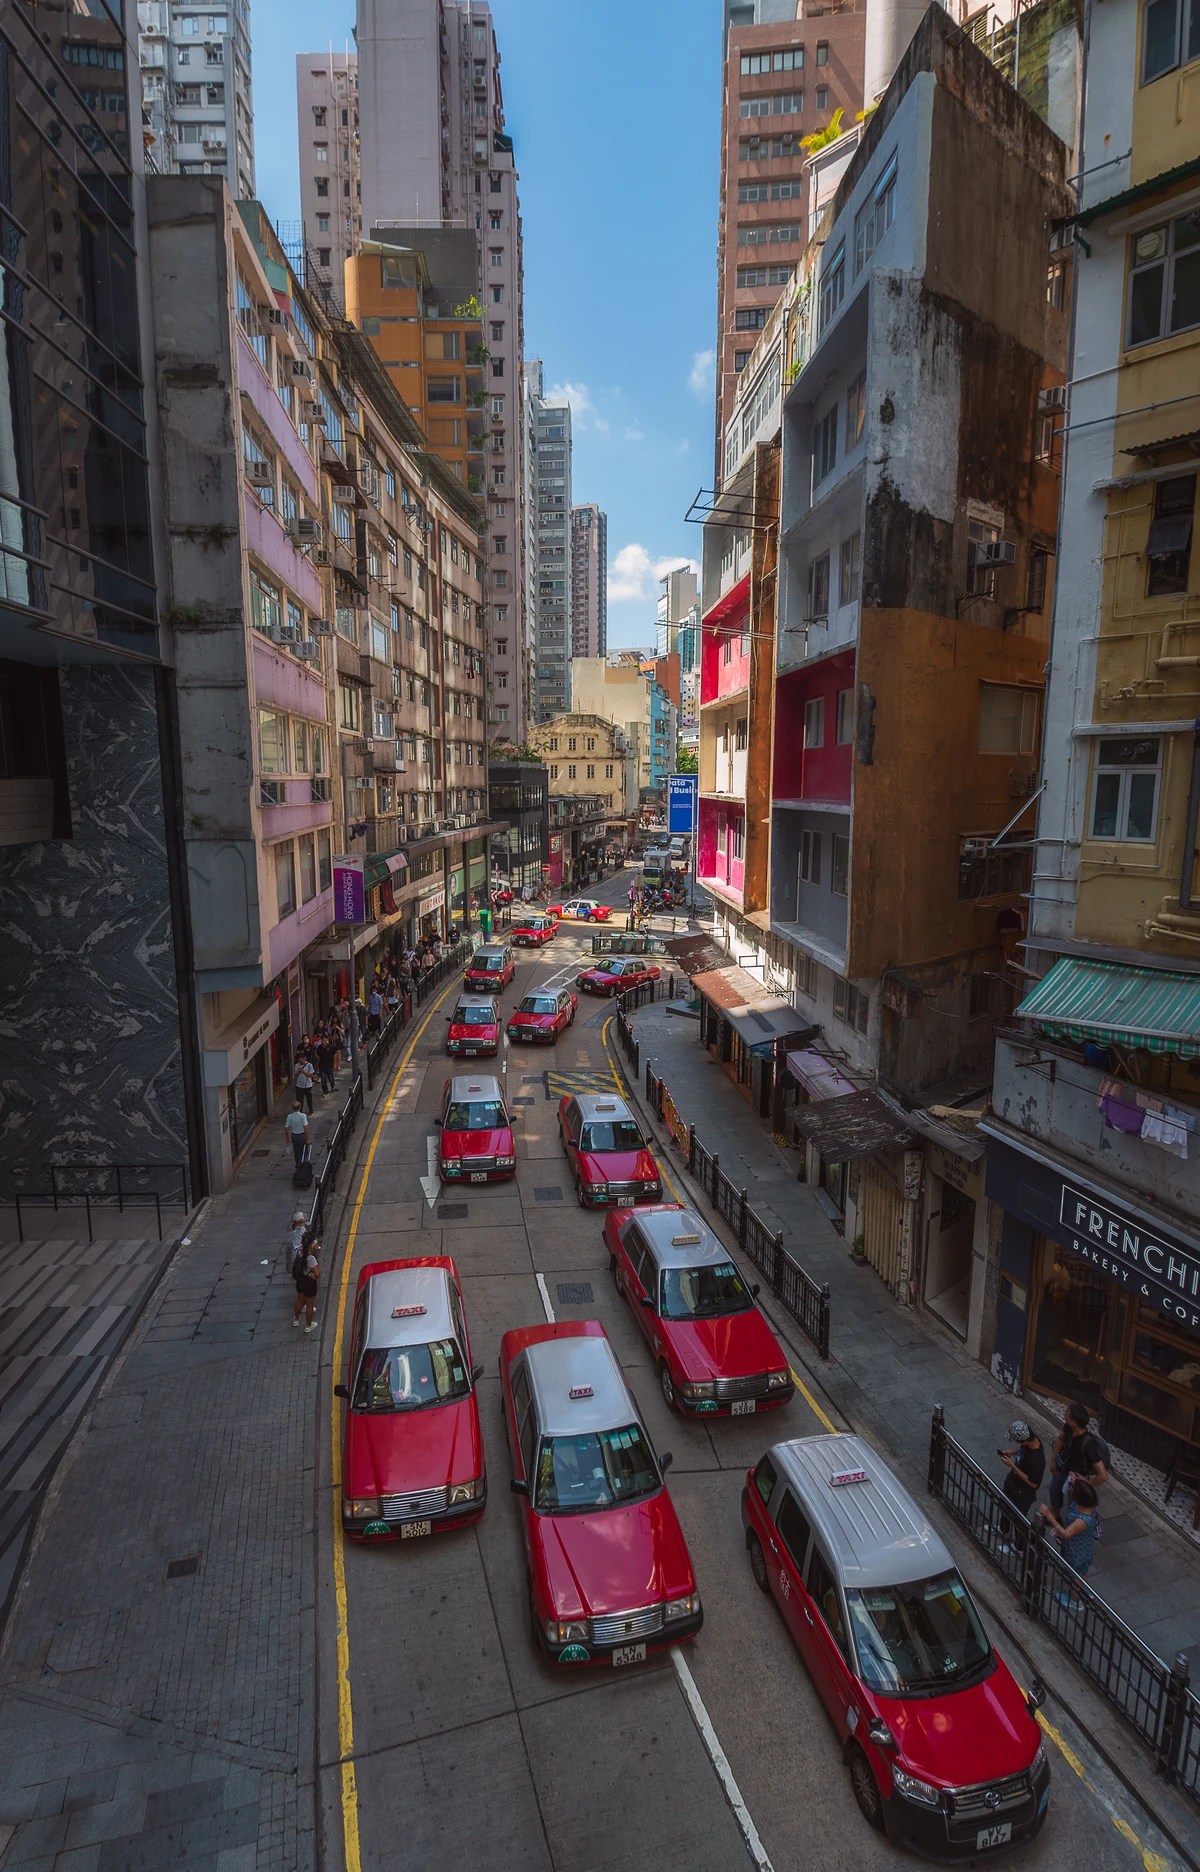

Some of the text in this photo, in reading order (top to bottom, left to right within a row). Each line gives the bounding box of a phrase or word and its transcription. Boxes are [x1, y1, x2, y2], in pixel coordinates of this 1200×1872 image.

[346, 872, 354, 896] HONG
[1073, 1240, 1200, 1326] BAKERY & COF
[396, 1306, 423, 1315] TAXI
[573, 1388, 591, 1396] TAXI
[837, 1471, 865, 1483] TAXI
[410, 1522, 422, 1530] SN
[405, 1528, 427, 1538] 5019
[622, 1646, 636, 1655] LN
[616, 1652, 642, 1665] 5348
[981, 1833, 1006, 1847] 8147
